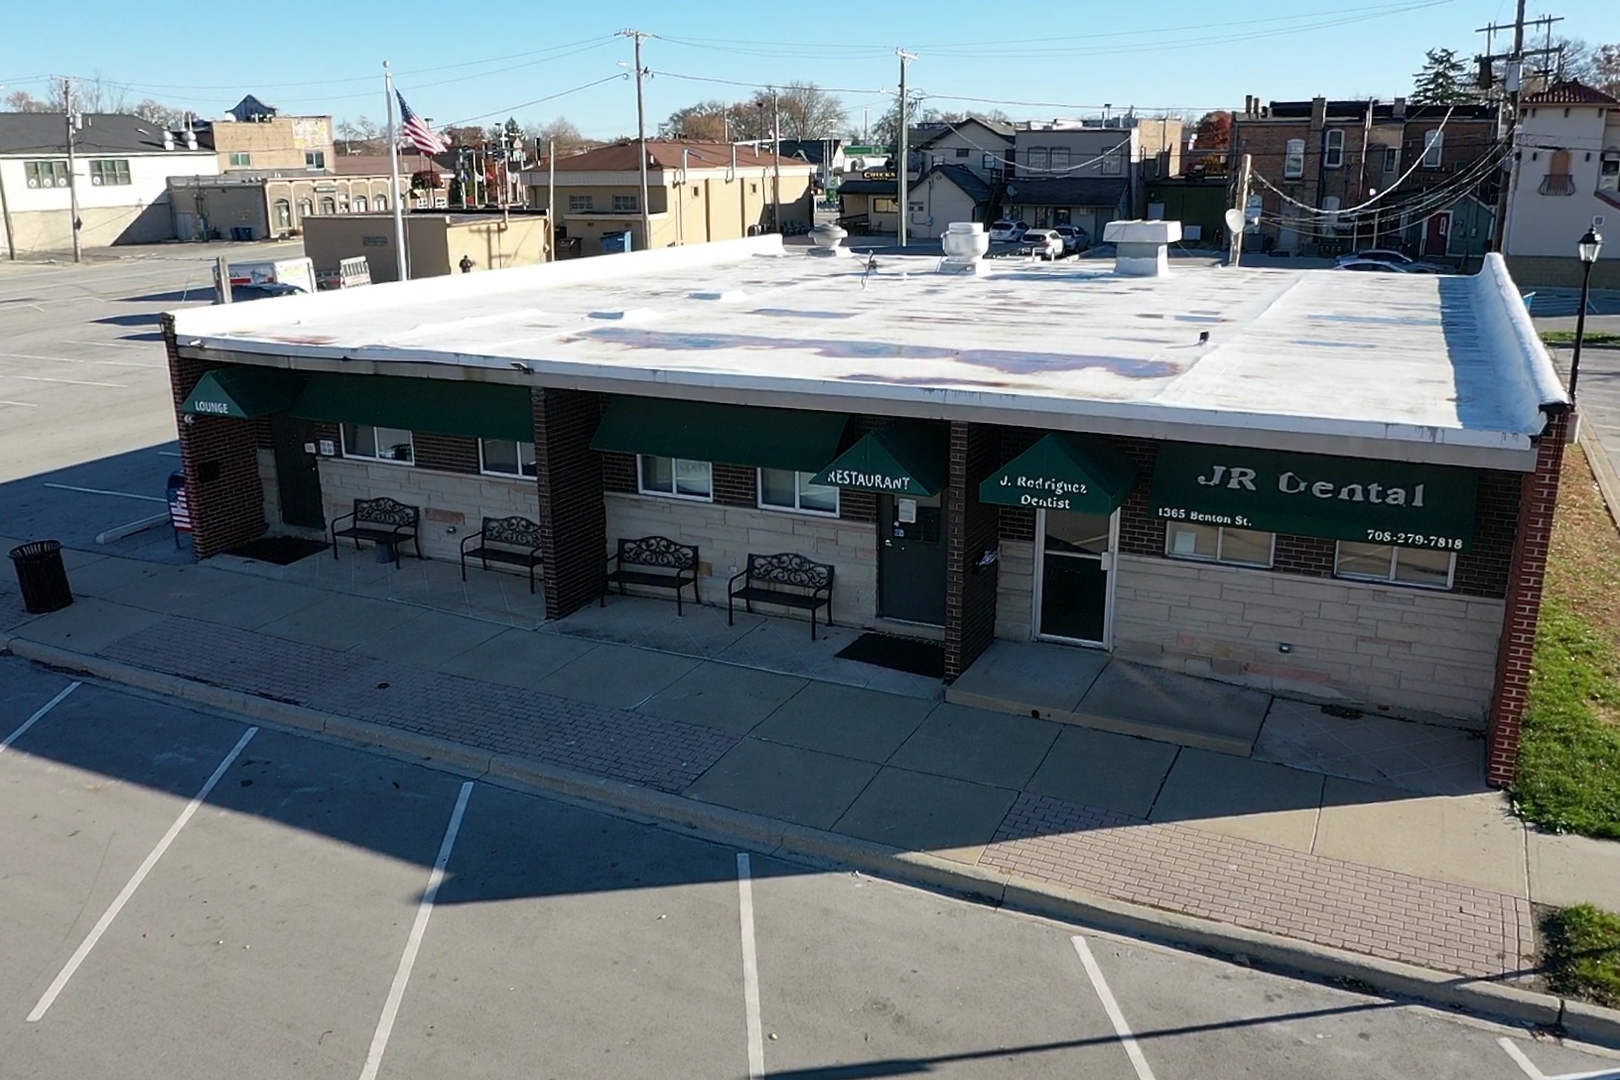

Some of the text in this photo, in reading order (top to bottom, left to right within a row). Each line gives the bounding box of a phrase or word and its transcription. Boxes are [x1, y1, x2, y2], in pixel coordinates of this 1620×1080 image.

[195, 401, 229, 413] LOUNGE
[827, 469, 910, 490] RESTAURANT
[999, 475, 1088, 495] J. Rodriguez
[1197, 465, 1425, 507] JR Dental
[1020, 494, 1071, 510] Dentist
[1157, 507, 1253, 527] 1365 Benton St.
[1366, 529, 1464, 550] 708-279-7818
